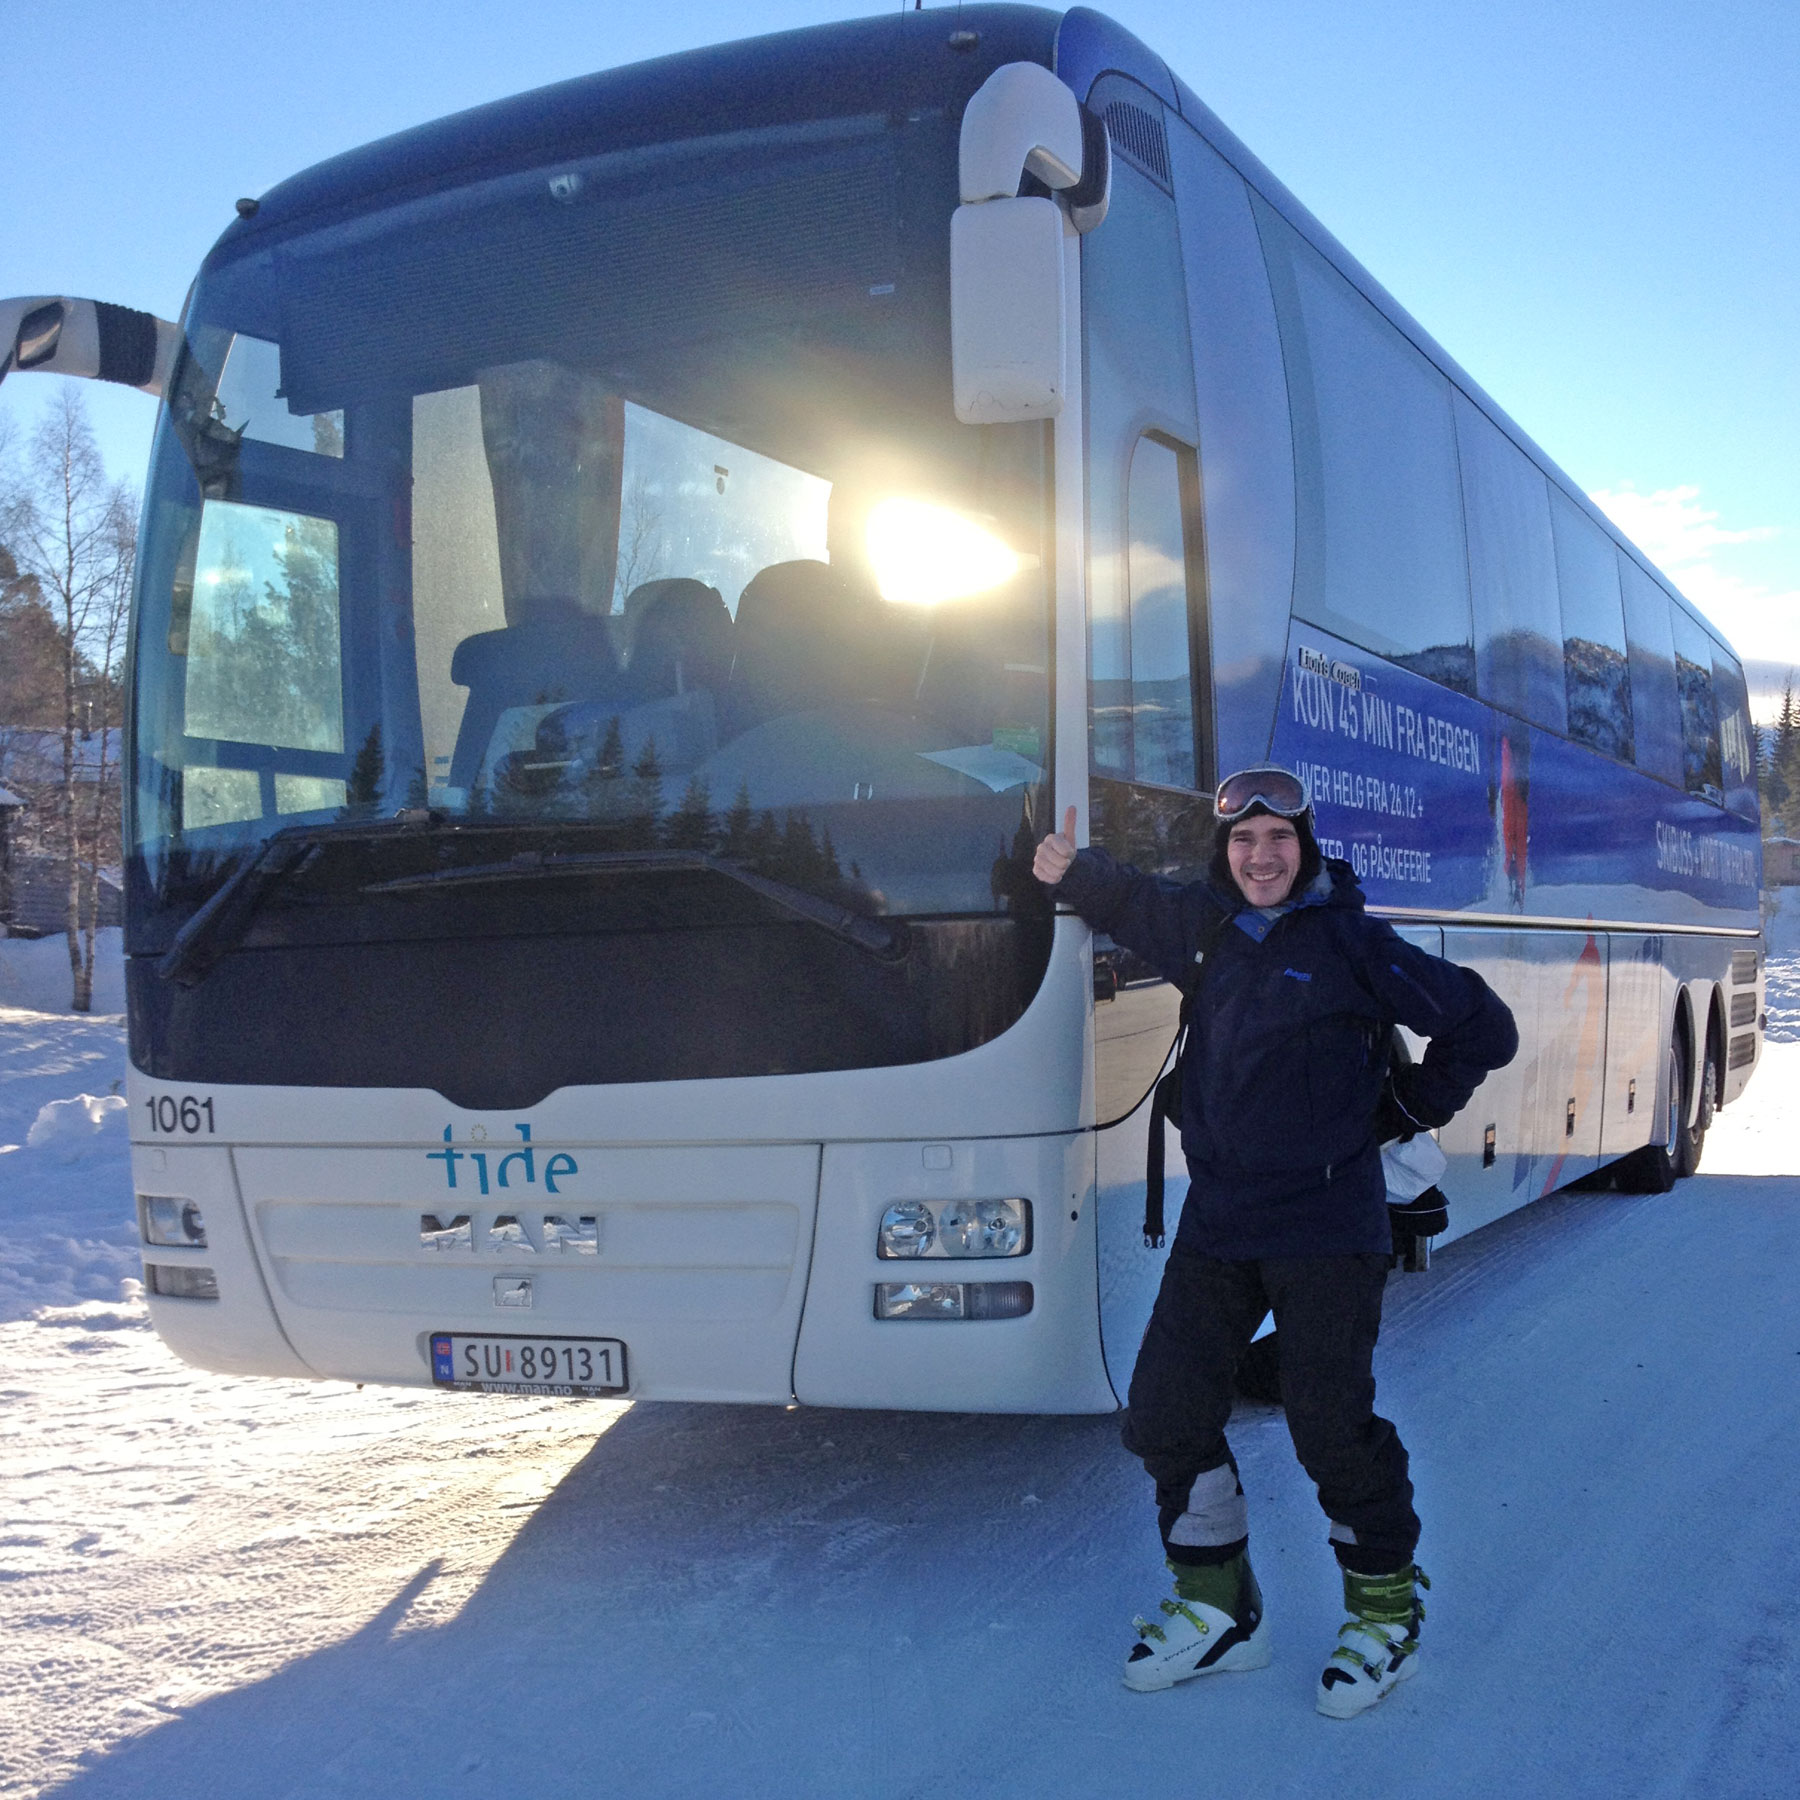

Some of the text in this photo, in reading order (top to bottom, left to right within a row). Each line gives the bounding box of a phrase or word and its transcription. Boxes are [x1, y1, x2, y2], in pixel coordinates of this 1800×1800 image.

[1292, 667, 1480, 775] KUN 45 MIN FRA BERGEN
[1333, 769, 1364, 809] HELG
[1366, 777, 1389, 814] FRA
[1390, 783, 1416, 819] 26.12
[1352, 842, 1367, 878] OG
[1370, 834, 1432, 883] PÅSKEFERIE
[145, 1095, 215, 1134] 1061
[426, 1123, 578, 1195] tide
[420, 1214, 599, 1254] MAN
[464, 1344, 612, 1382] SU 89131
[481, 1381, 573, 1396] www.man.no
